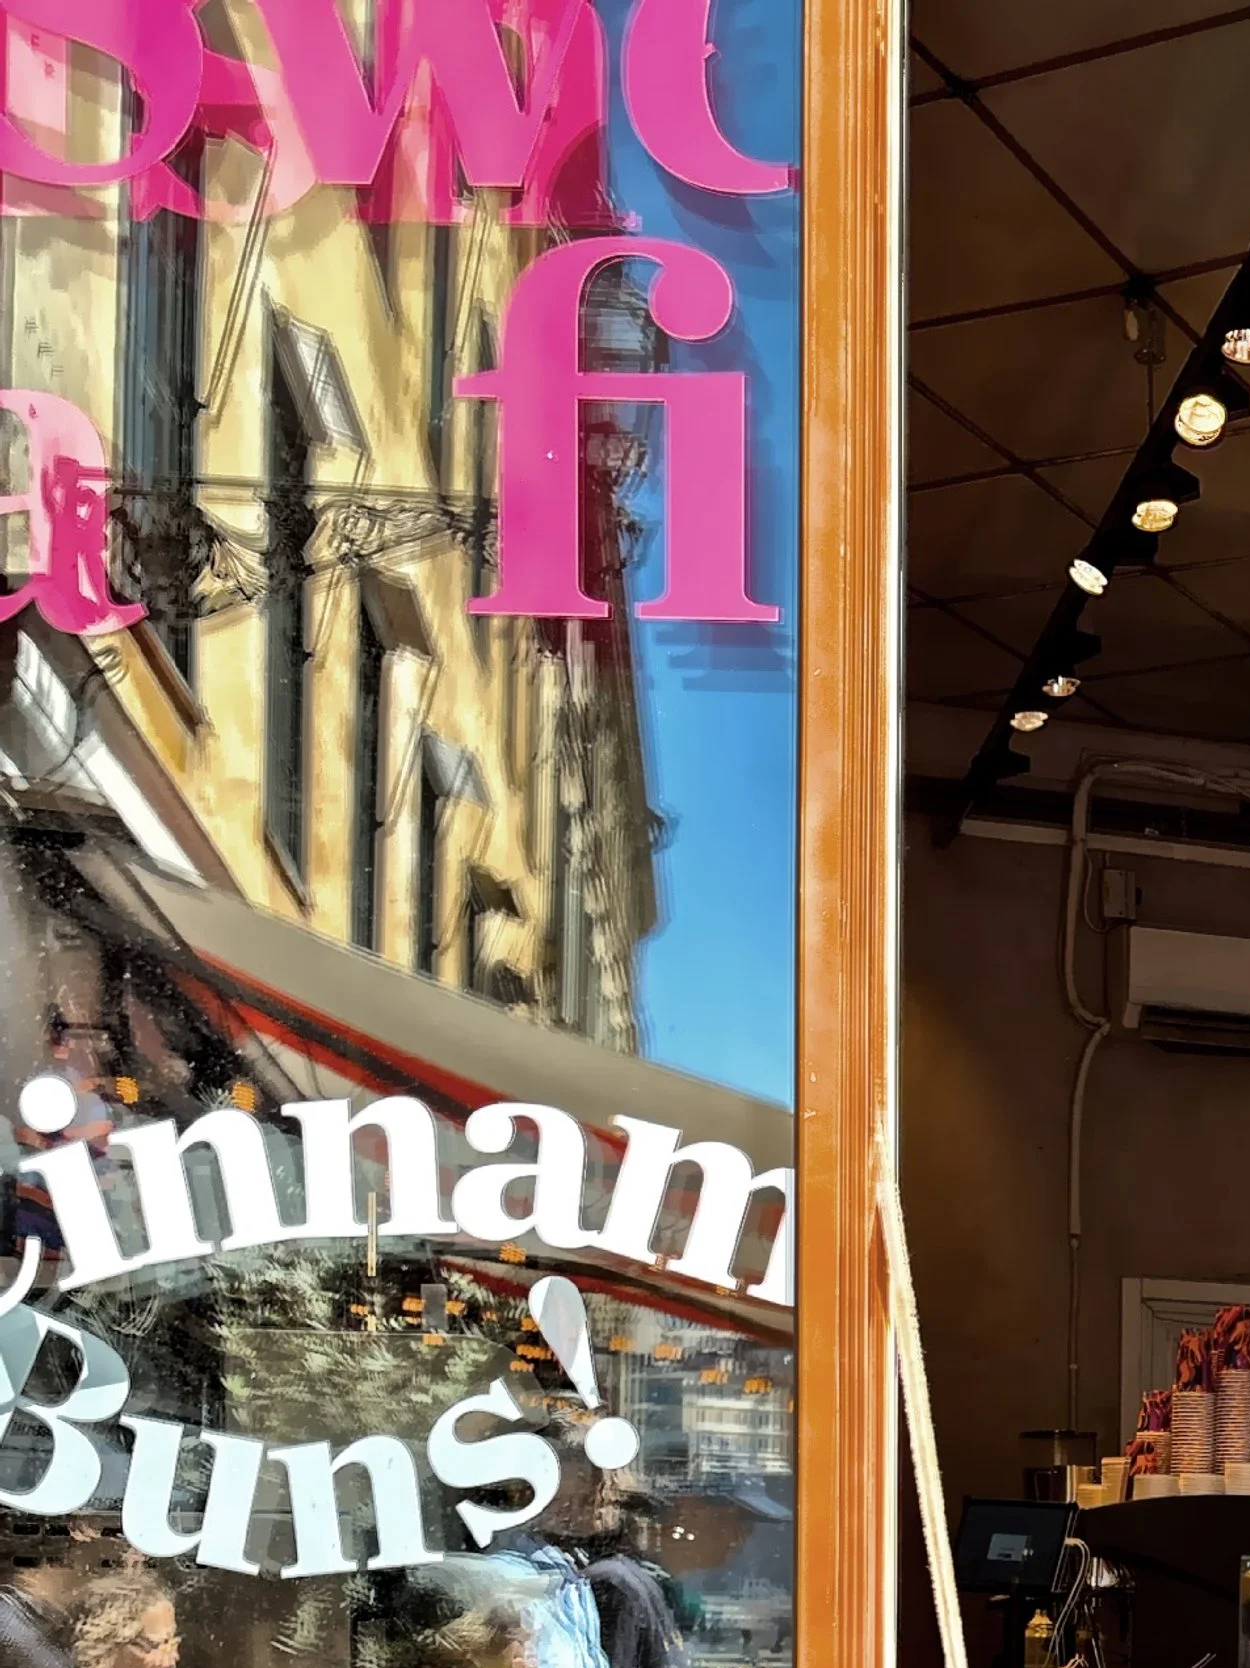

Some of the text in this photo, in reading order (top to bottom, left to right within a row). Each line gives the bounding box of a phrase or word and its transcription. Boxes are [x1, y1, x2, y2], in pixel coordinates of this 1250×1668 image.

[453, 236, 782, 622] fi
[0, 1075, 795, 1318] innam
[0, 1276, 640, 1579] Buns!
